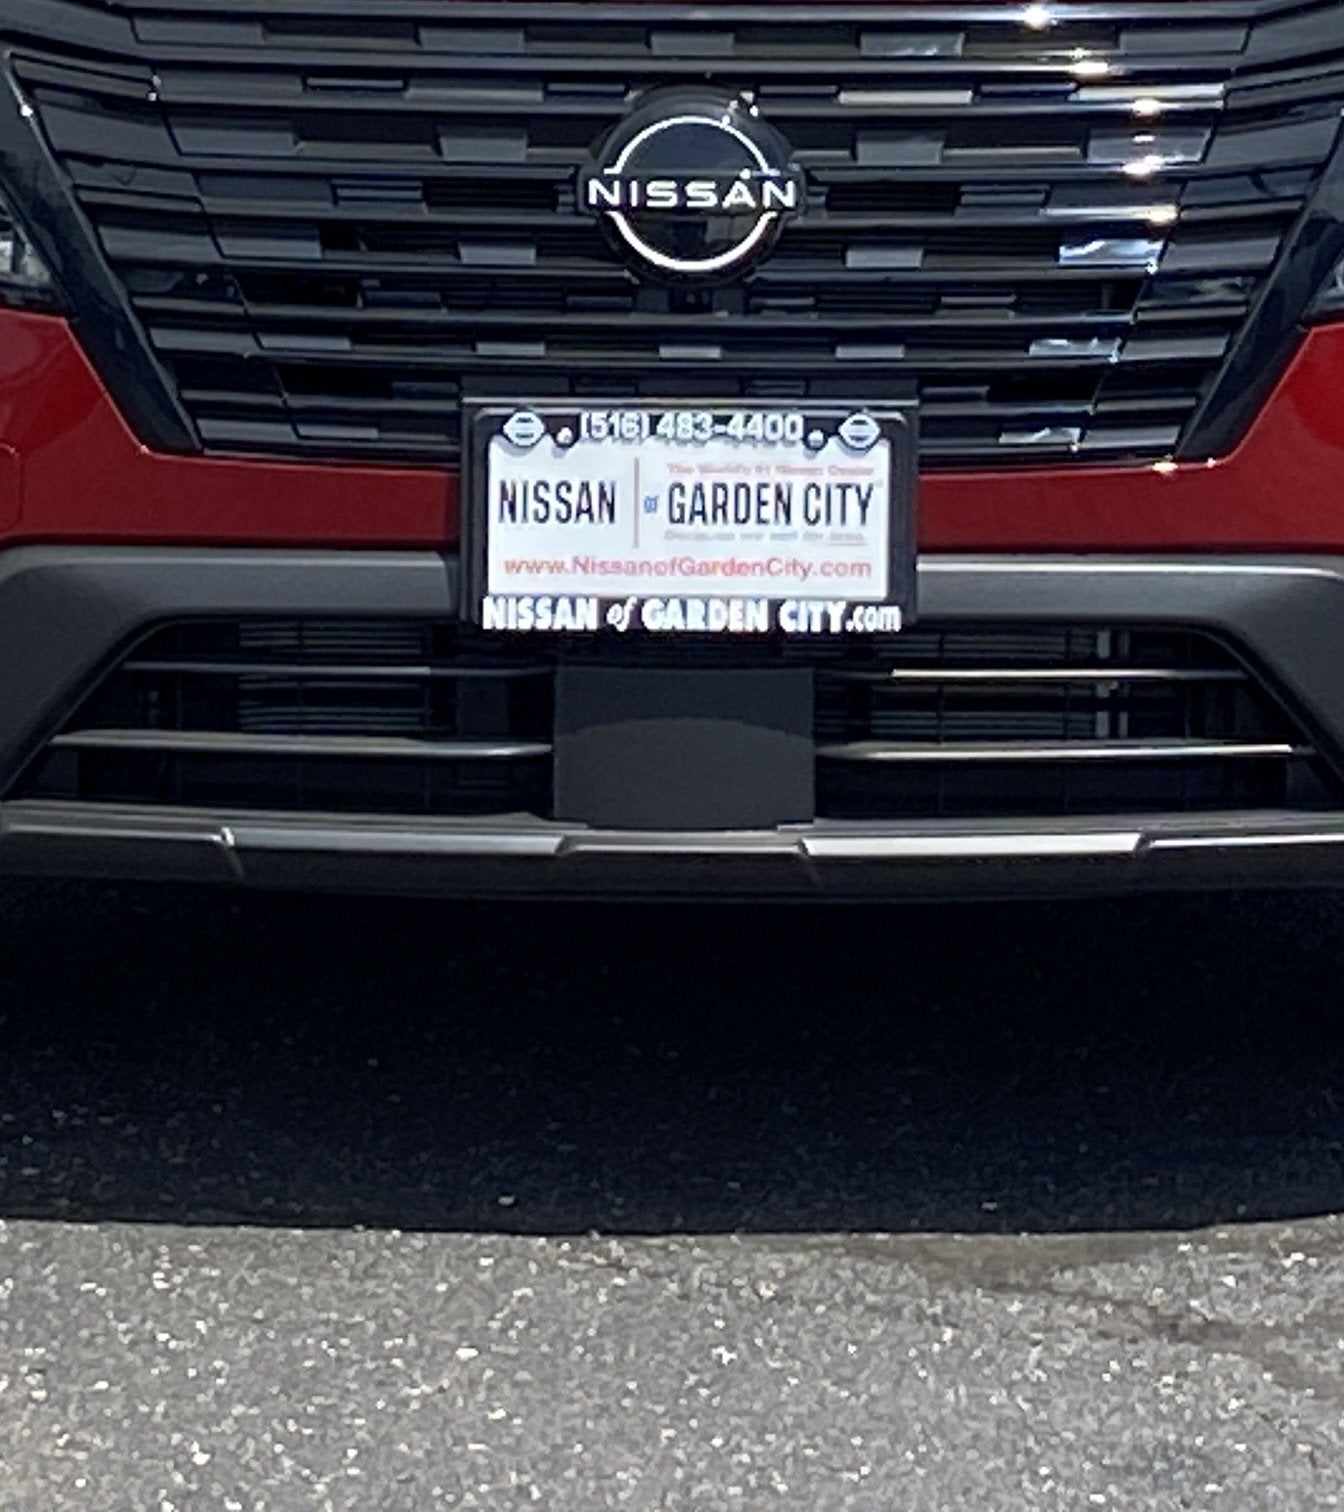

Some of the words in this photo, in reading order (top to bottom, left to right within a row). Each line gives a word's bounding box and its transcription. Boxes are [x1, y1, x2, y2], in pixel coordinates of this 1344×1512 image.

[588, 179, 796, 208] NISSAN
[581, 412, 650, 439] (516)
[657, 412, 804, 440] 483-4400
[499, 479, 616, 524] NISSAN
[667, 482, 793, 526] GARDEN
[802, 482, 874, 526] CITY
[503, 556, 872, 581] www.NissanofGardenCity.com
[482, 596, 598, 631] NISSAN
[606, 596, 638, 632] of
[642, 597, 769, 632] GARDEN
[779, 599, 902, 633] CITY.com
